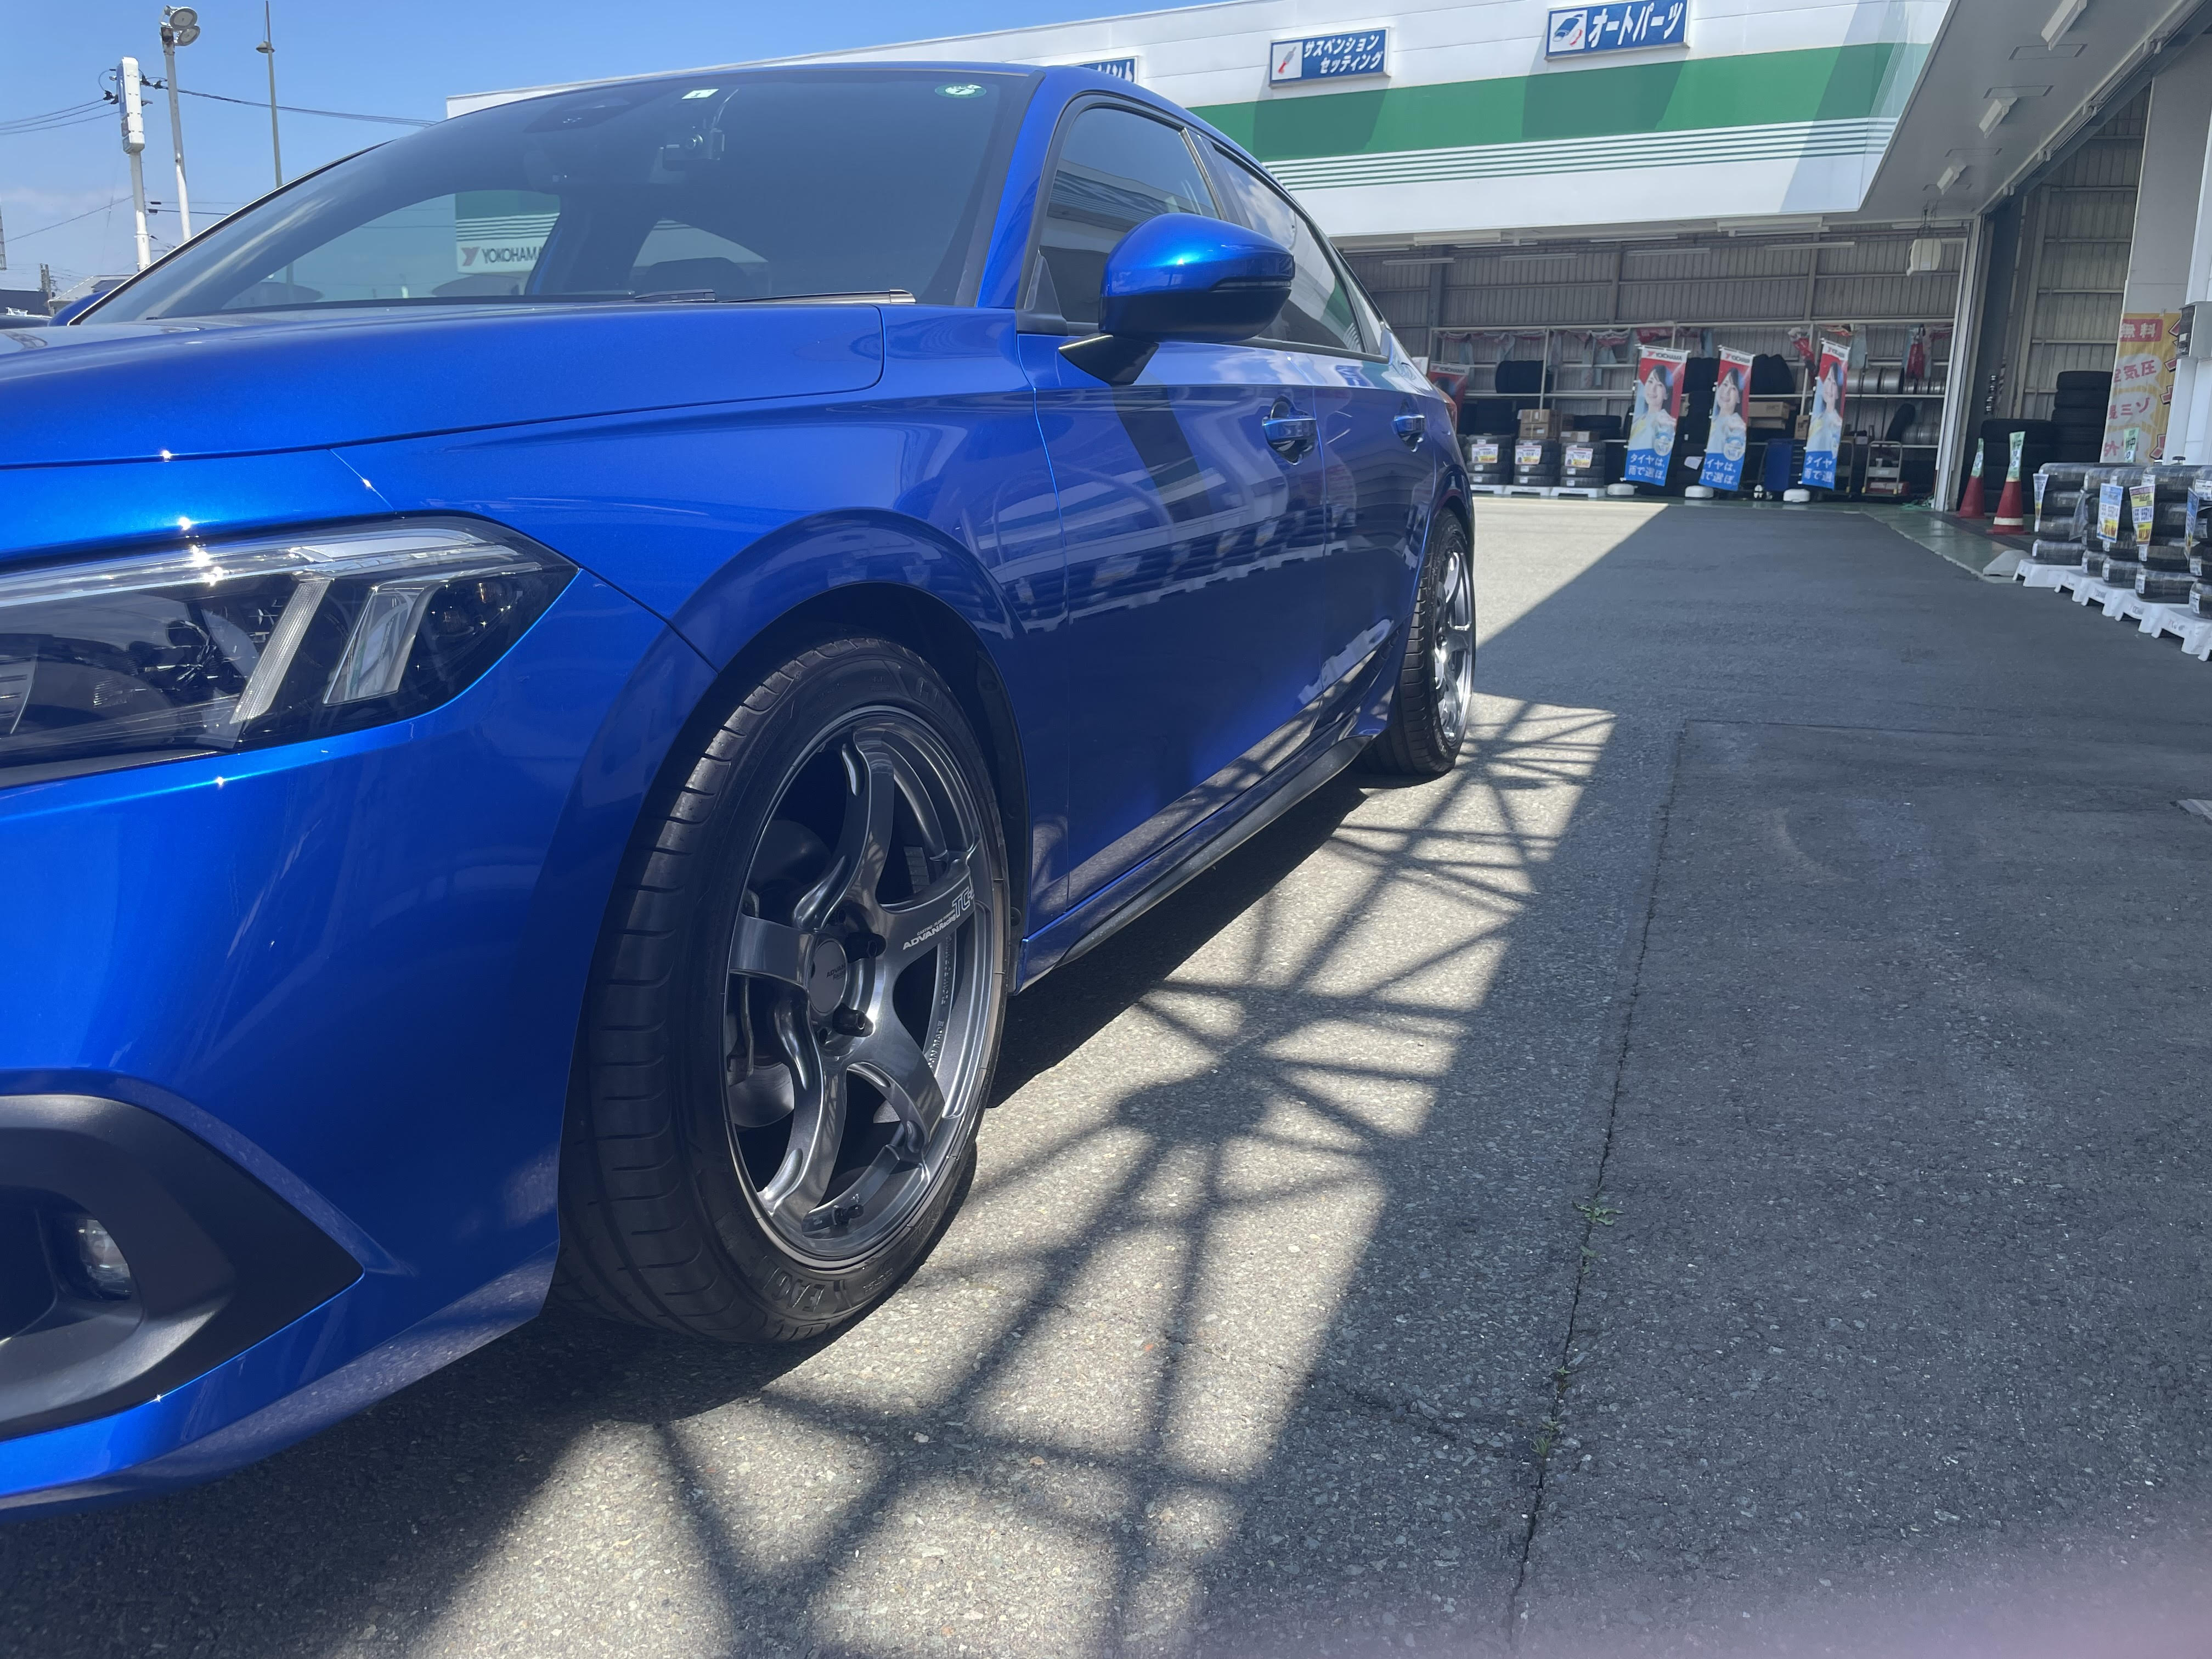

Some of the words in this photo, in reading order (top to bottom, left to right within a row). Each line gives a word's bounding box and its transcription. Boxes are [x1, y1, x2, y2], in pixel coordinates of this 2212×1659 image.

[1588, 2, 1684, 48] オートパーツ
[1304, 35, 1380, 58] サスペンション
[1319, 50, 1384, 74] セッティング
[2119, 322, 2156, 338] 無料
